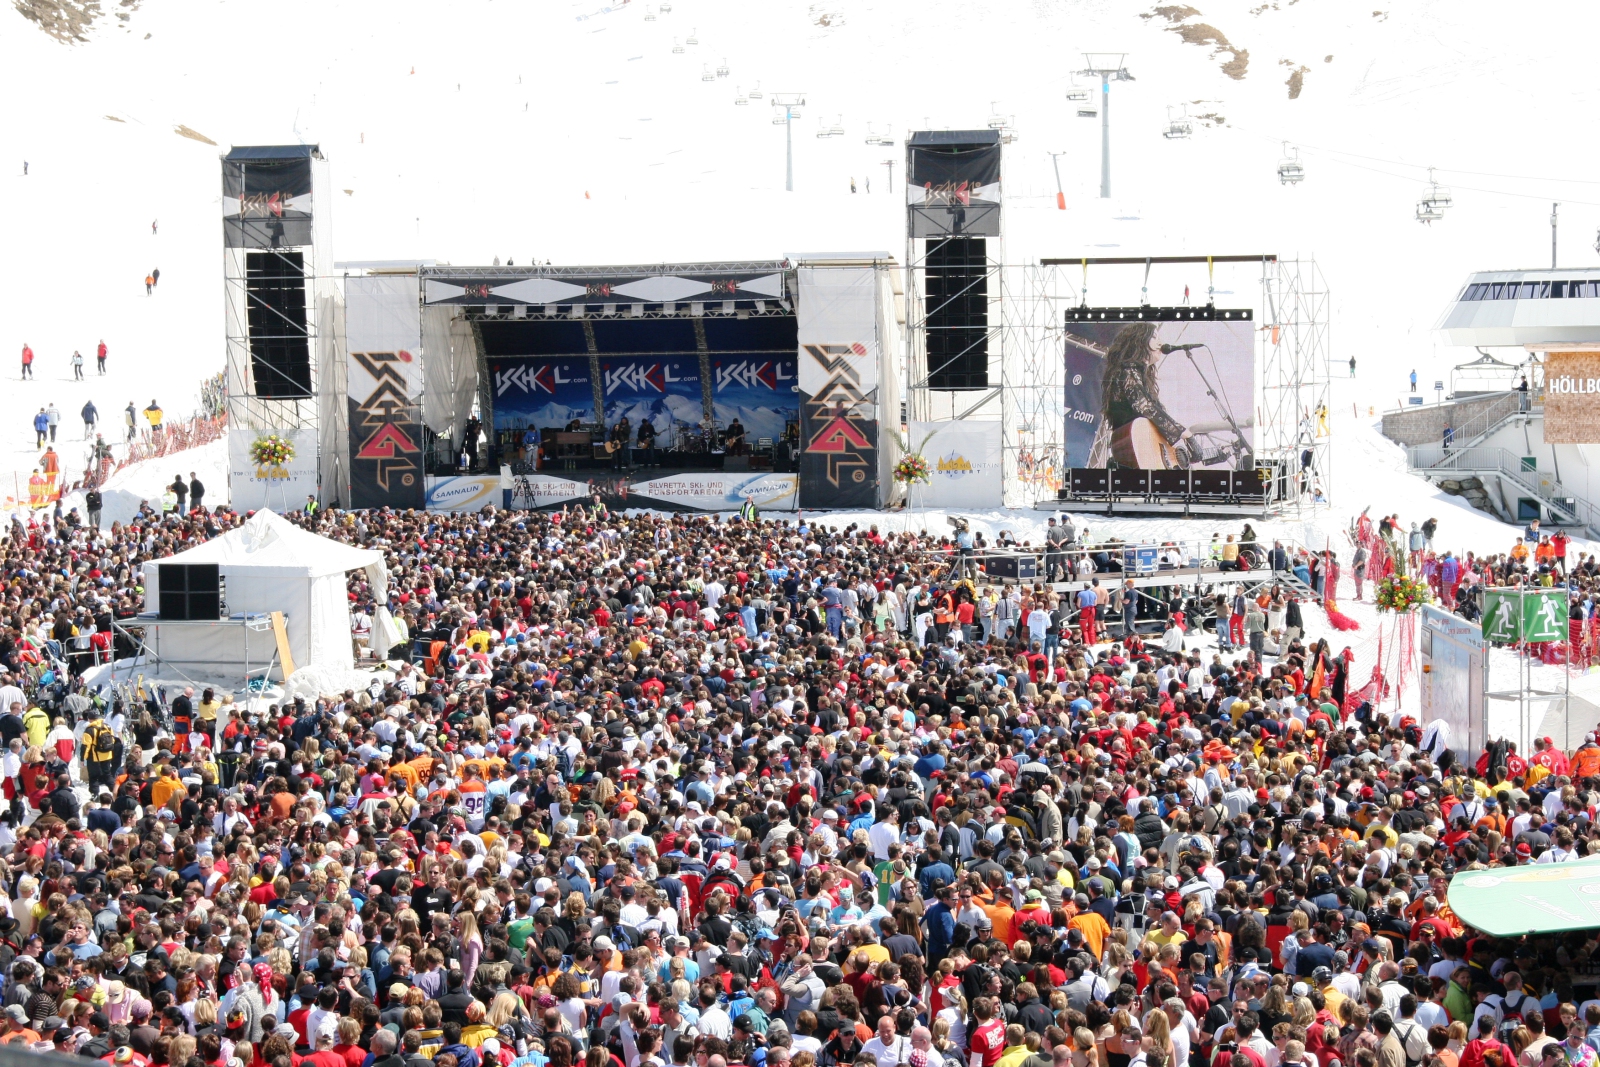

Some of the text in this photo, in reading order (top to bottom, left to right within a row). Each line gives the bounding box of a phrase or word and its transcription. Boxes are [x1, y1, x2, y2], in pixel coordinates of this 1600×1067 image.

[435, 485, 480, 499] SAMNAUN
[743, 482, 789, 495] SAMNAUN
[465, 797, 483, 815] 99
